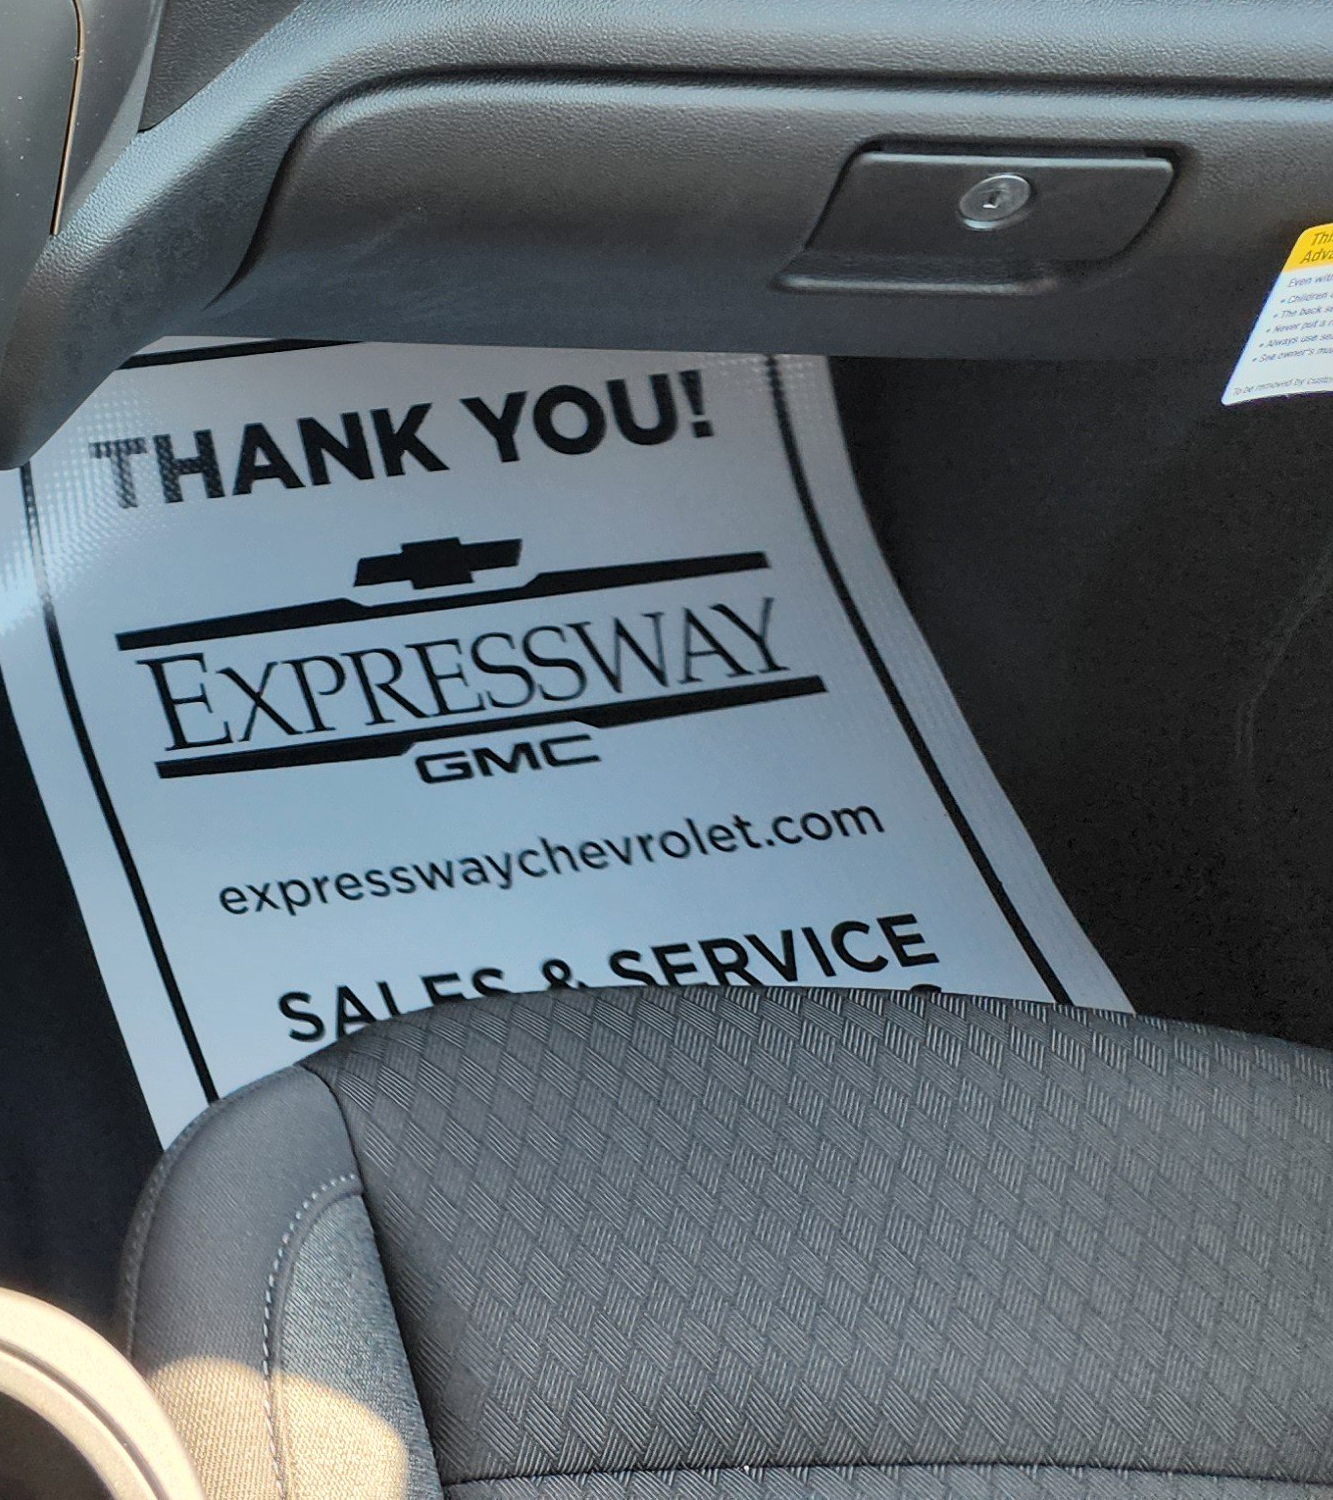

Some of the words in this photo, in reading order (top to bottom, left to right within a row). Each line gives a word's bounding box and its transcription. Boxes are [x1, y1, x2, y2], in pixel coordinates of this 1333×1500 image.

[92, 403, 448, 510] THANK
[461, 368, 714, 465] YOU!
[135, 596, 791, 753] EXPRESSWAY
[415, 734, 601, 785] GMC
[218, 799, 887, 918] expresswaychevrolet.com
[608, 912, 941, 989] SERVICE
